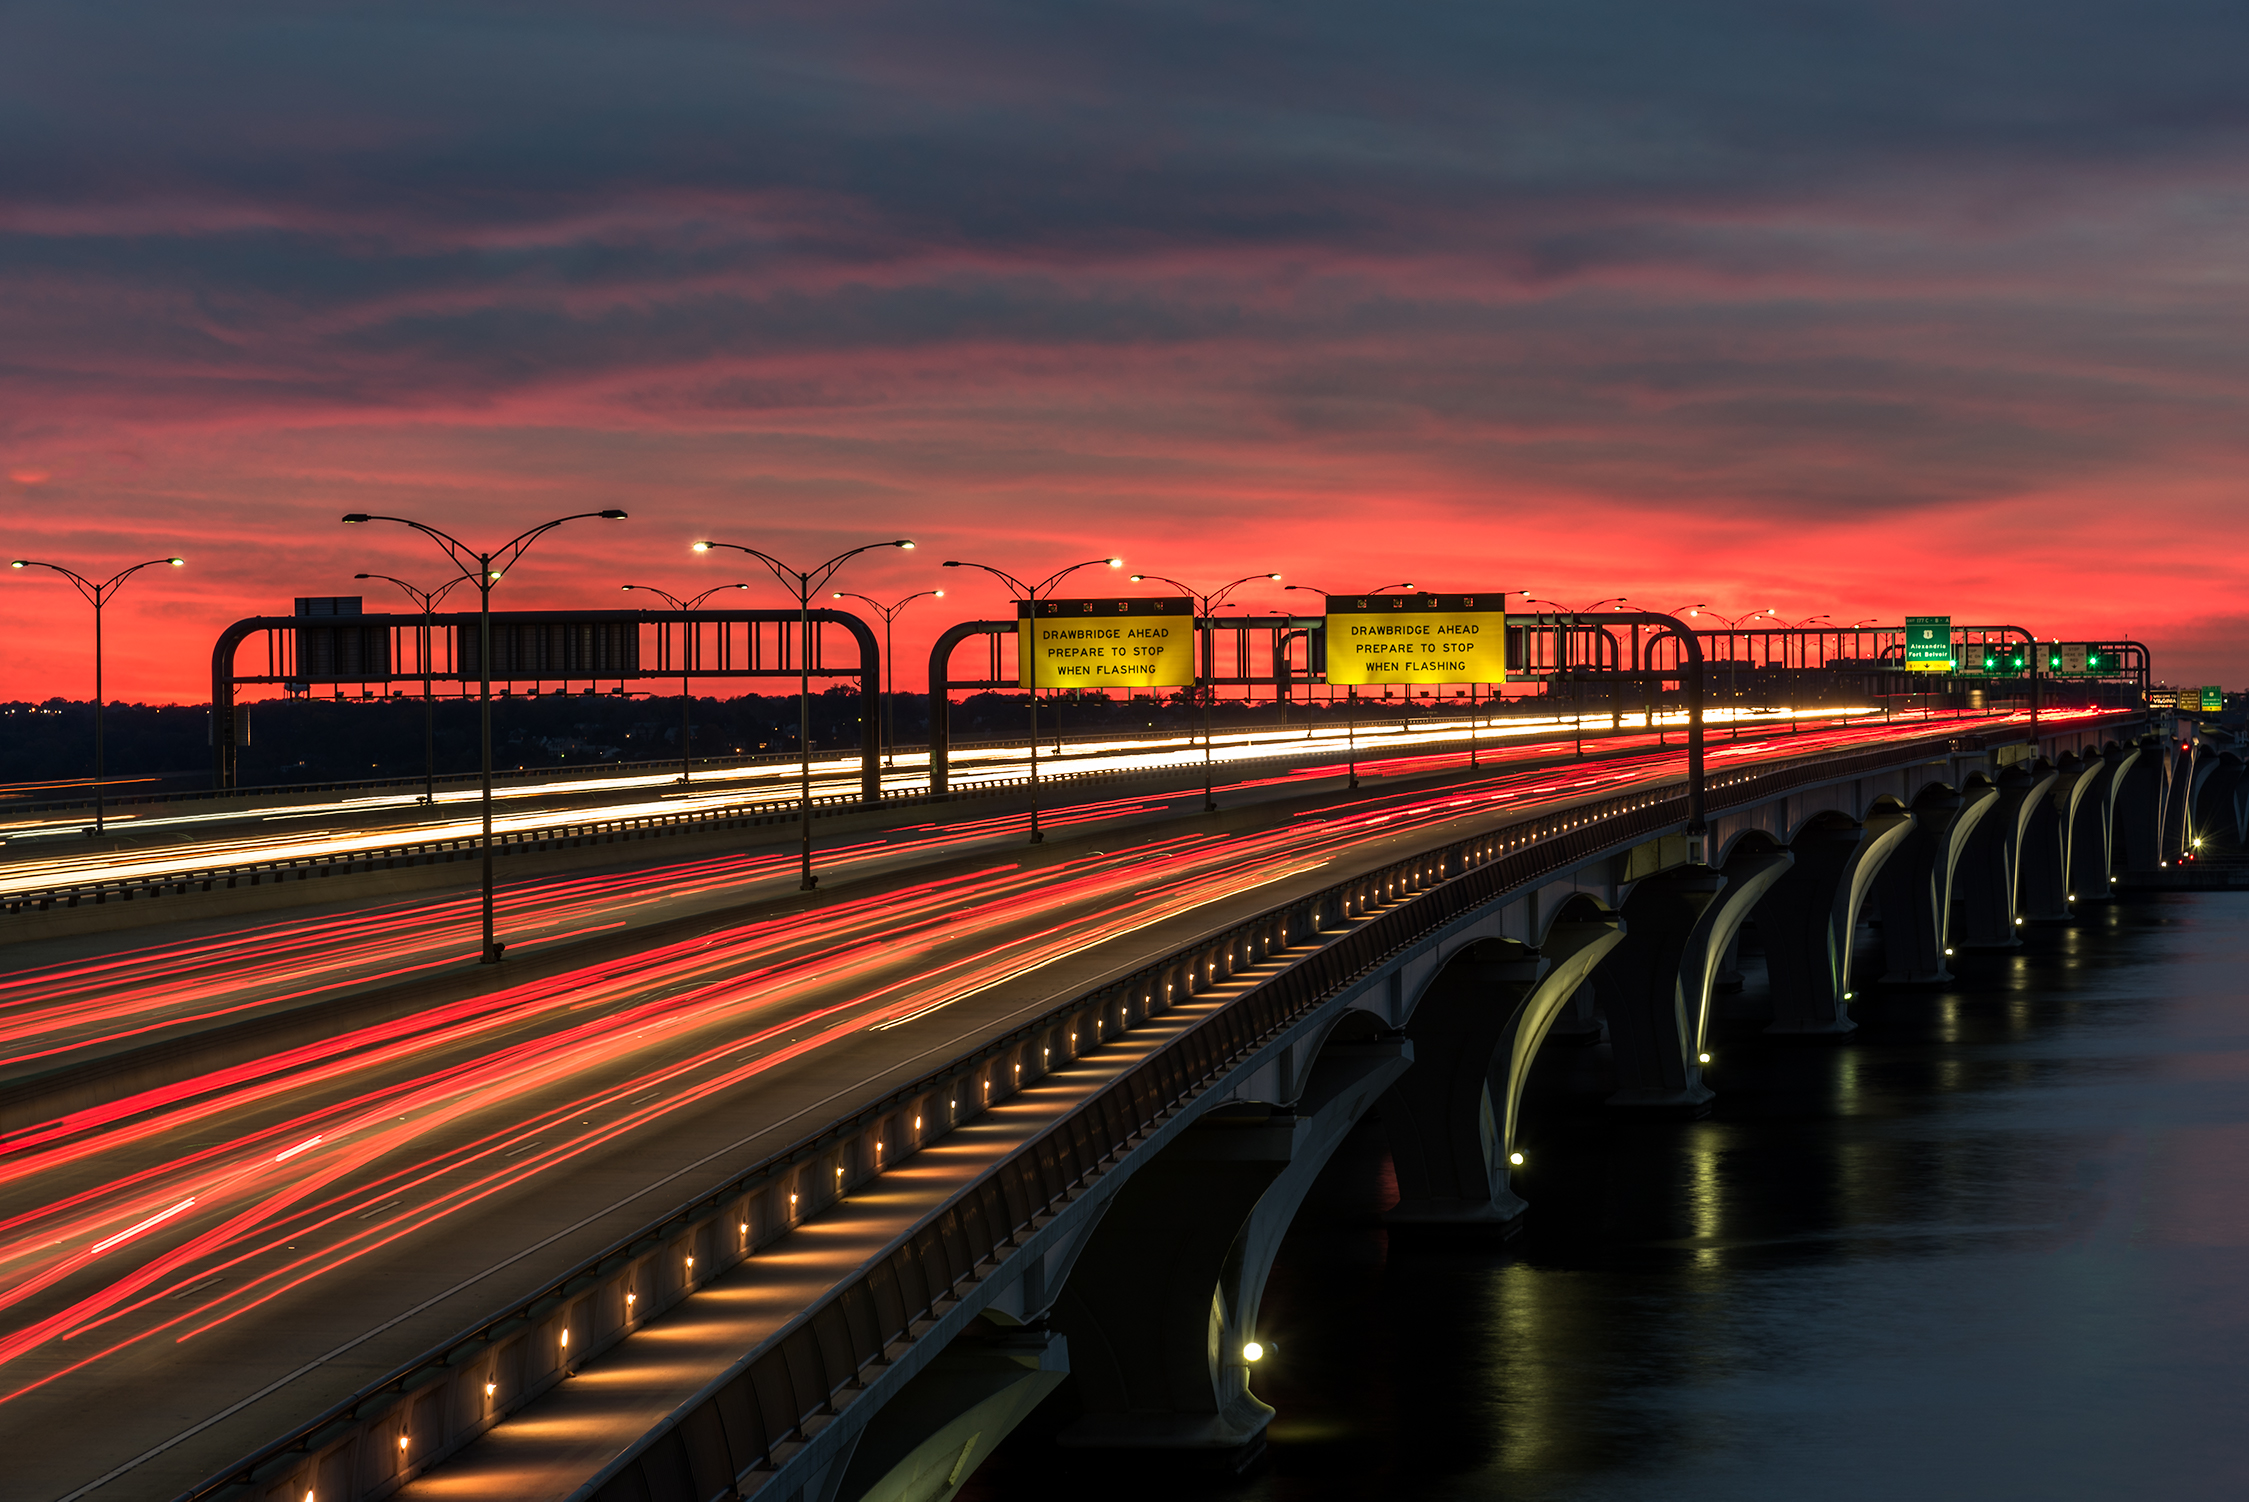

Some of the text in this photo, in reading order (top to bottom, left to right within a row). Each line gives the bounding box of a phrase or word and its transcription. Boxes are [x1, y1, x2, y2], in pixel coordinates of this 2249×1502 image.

[1043, 628, 1169, 639] DRAWBRIDGE AHEAD
[1351, 625, 1479, 635] DRAWBRIDGE AHEAD
[1048, 646, 1164, 657] PREPARE TO STOP
[1356, 643, 1475, 653] PREPARE TO STOP
[1057, 664, 1156, 675] WHEN FLASHING
[1366, 661, 1466, 671] WHEN FLASHING
